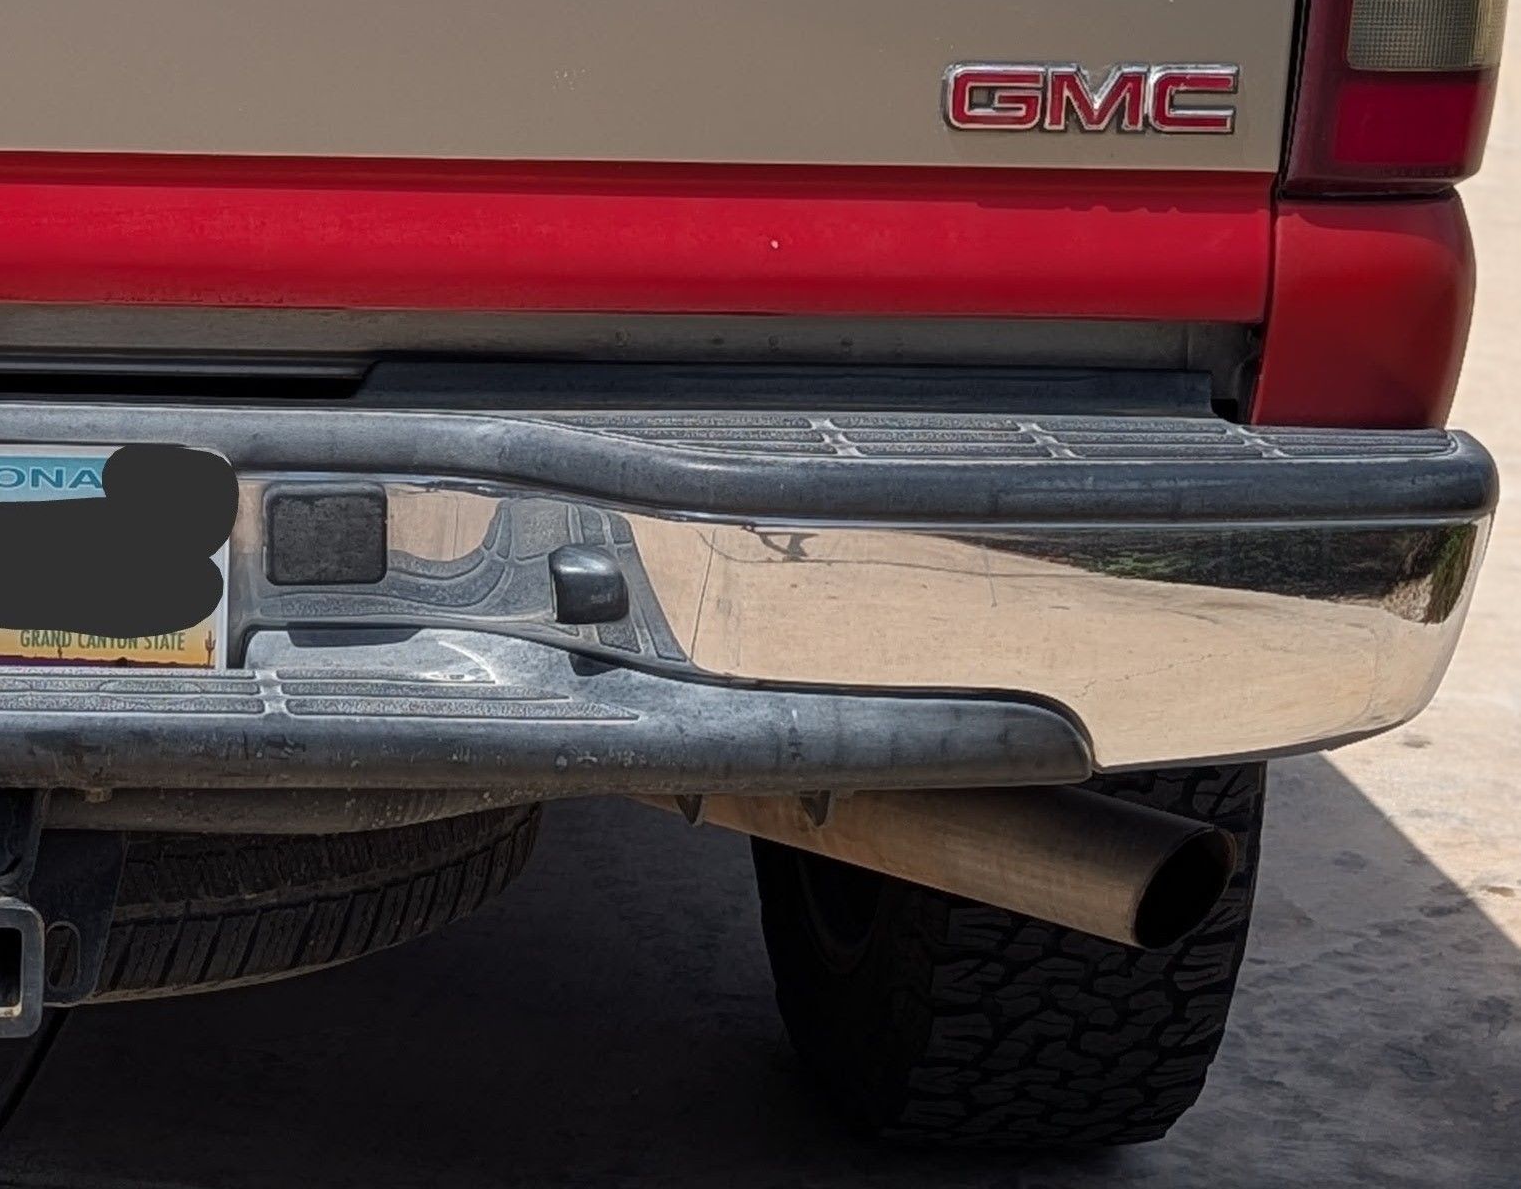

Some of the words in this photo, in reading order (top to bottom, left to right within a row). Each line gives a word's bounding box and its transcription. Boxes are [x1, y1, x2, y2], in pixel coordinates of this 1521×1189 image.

[941, 62, 1239, 133] GMC
[20, 630, 72, 648] GRAND
[143, 633, 186, 651] STATE
